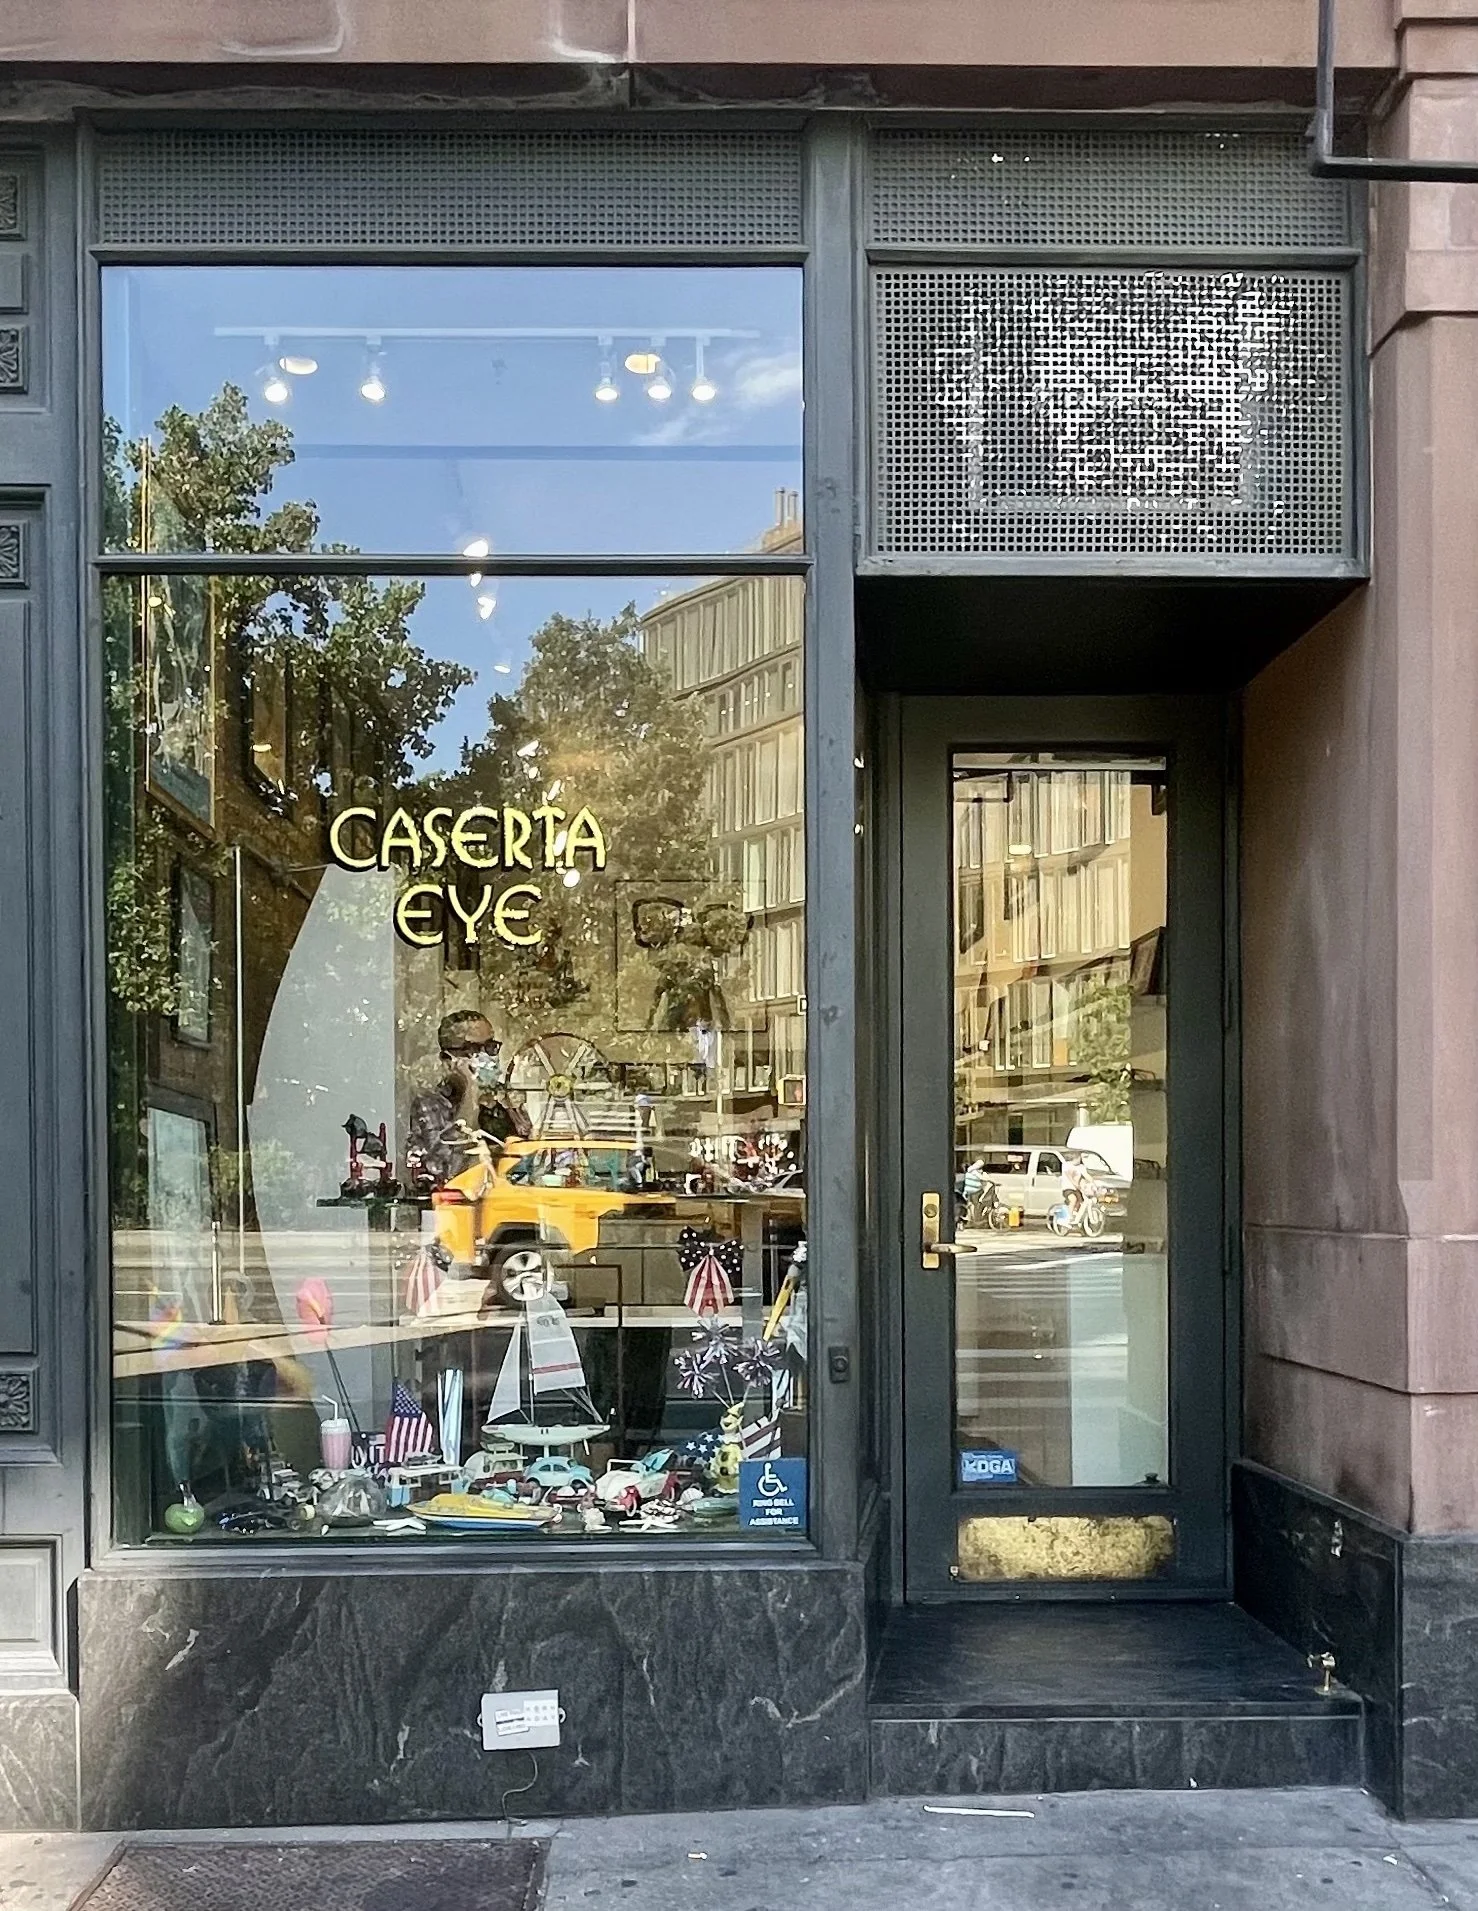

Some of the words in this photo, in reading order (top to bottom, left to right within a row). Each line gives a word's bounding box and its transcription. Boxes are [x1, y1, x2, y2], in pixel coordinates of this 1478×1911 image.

[329, 805, 607, 871] CASERTA
[394, 883, 543, 947] EYE
[765, 1508, 782, 1516] FOR
